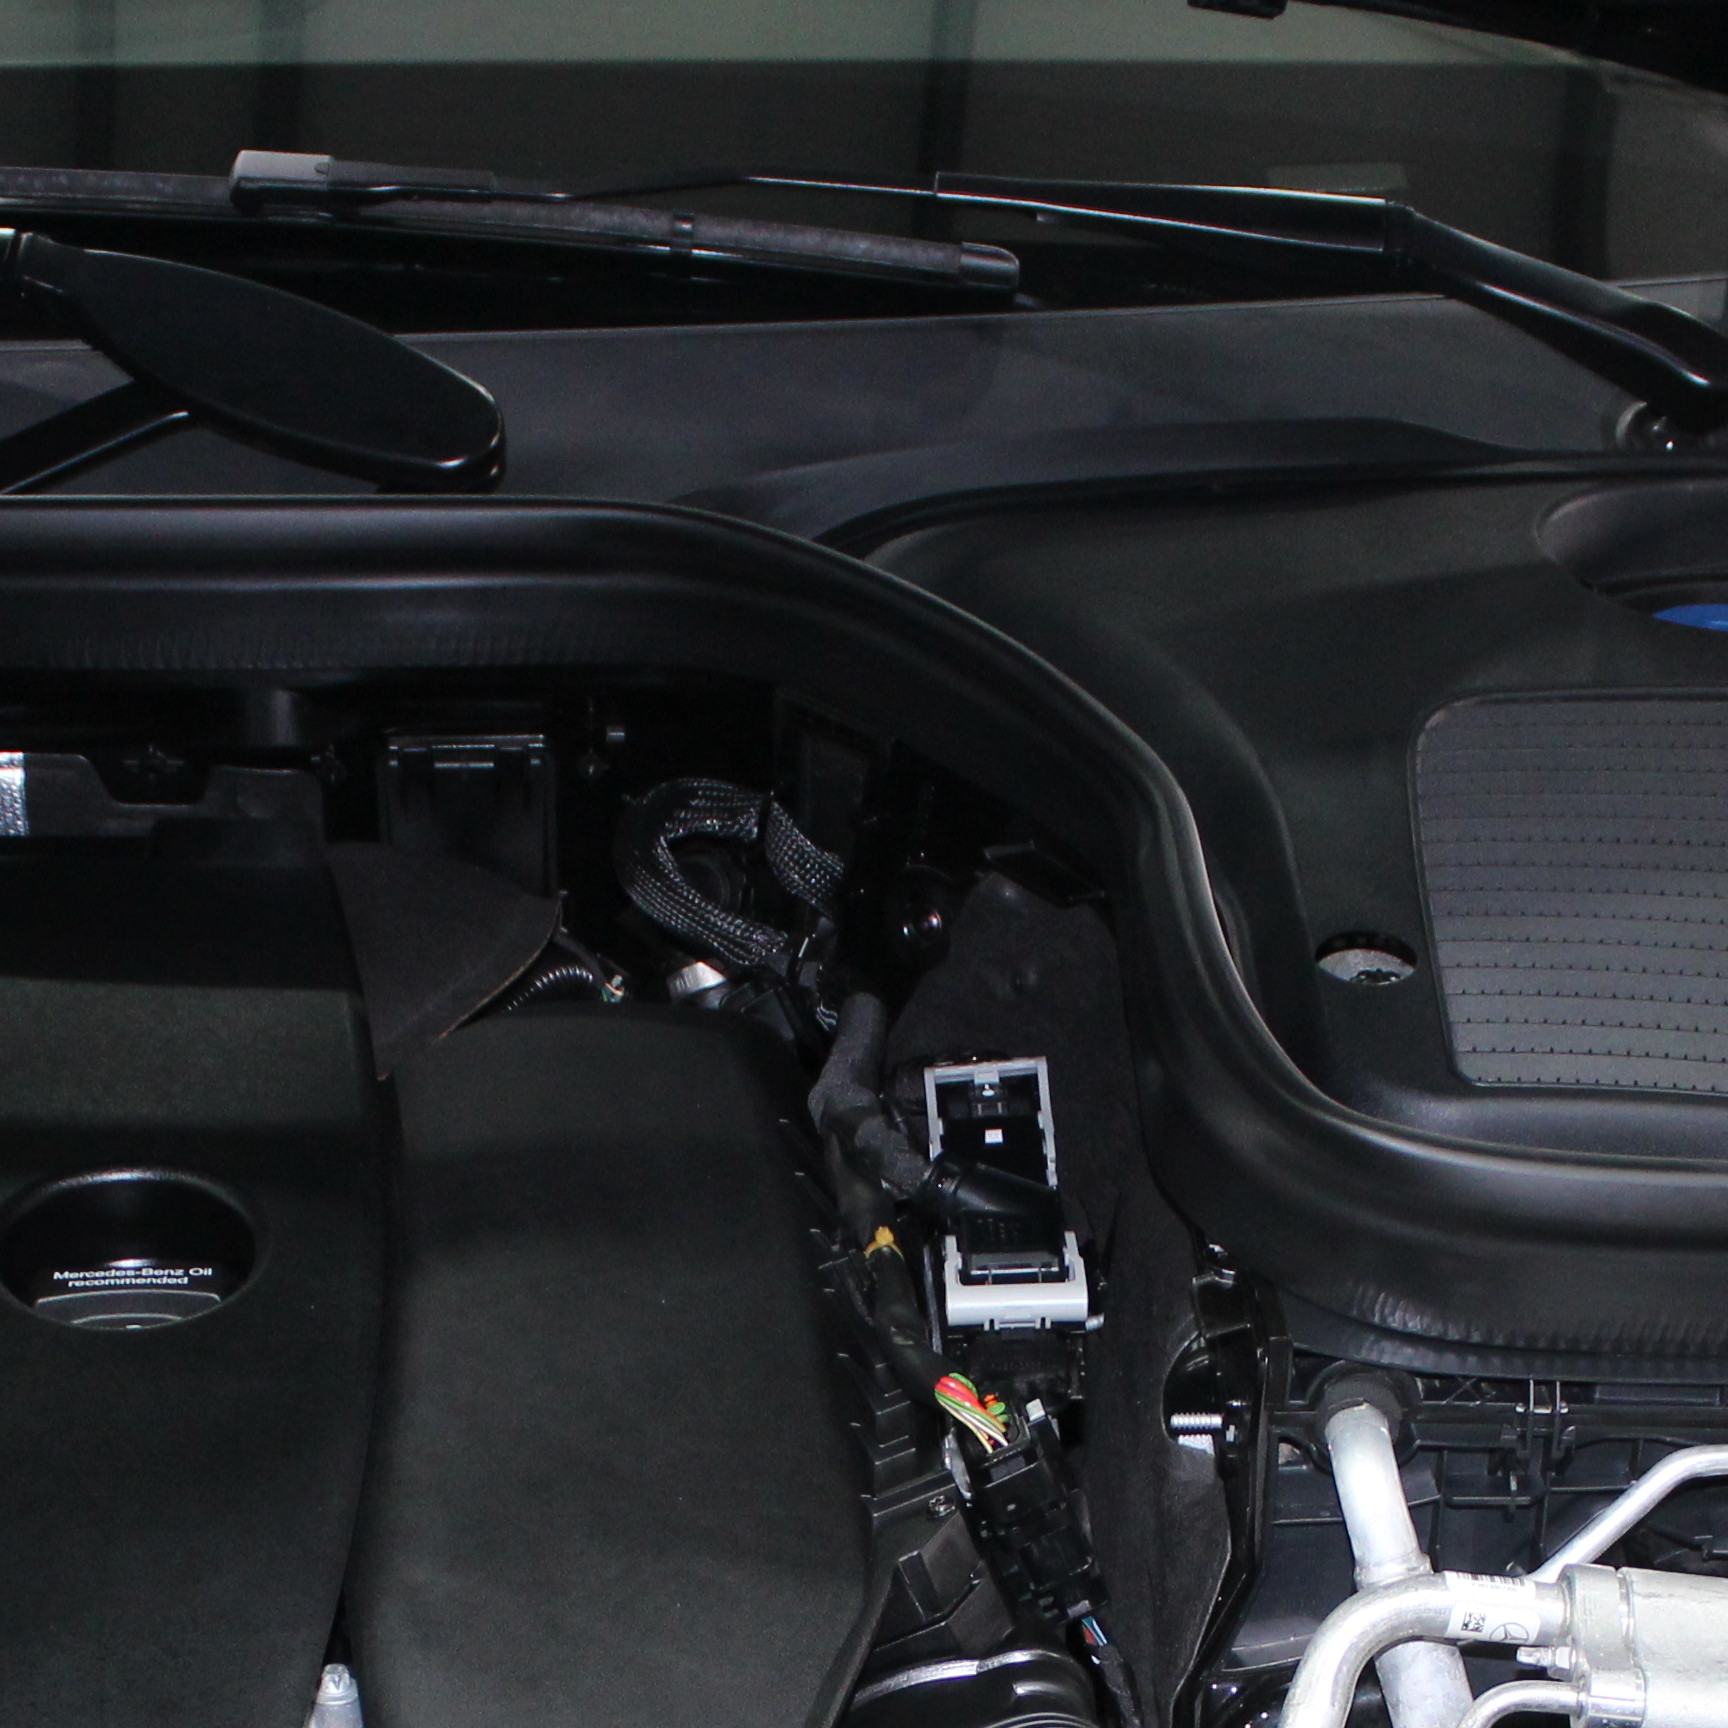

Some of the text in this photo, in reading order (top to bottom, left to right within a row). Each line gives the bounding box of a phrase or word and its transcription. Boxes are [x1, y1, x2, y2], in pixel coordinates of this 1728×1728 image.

[53, 1267, 212, 1280] Mercedes-Benz Oil
[68, 1275, 189, 1287] recommended
